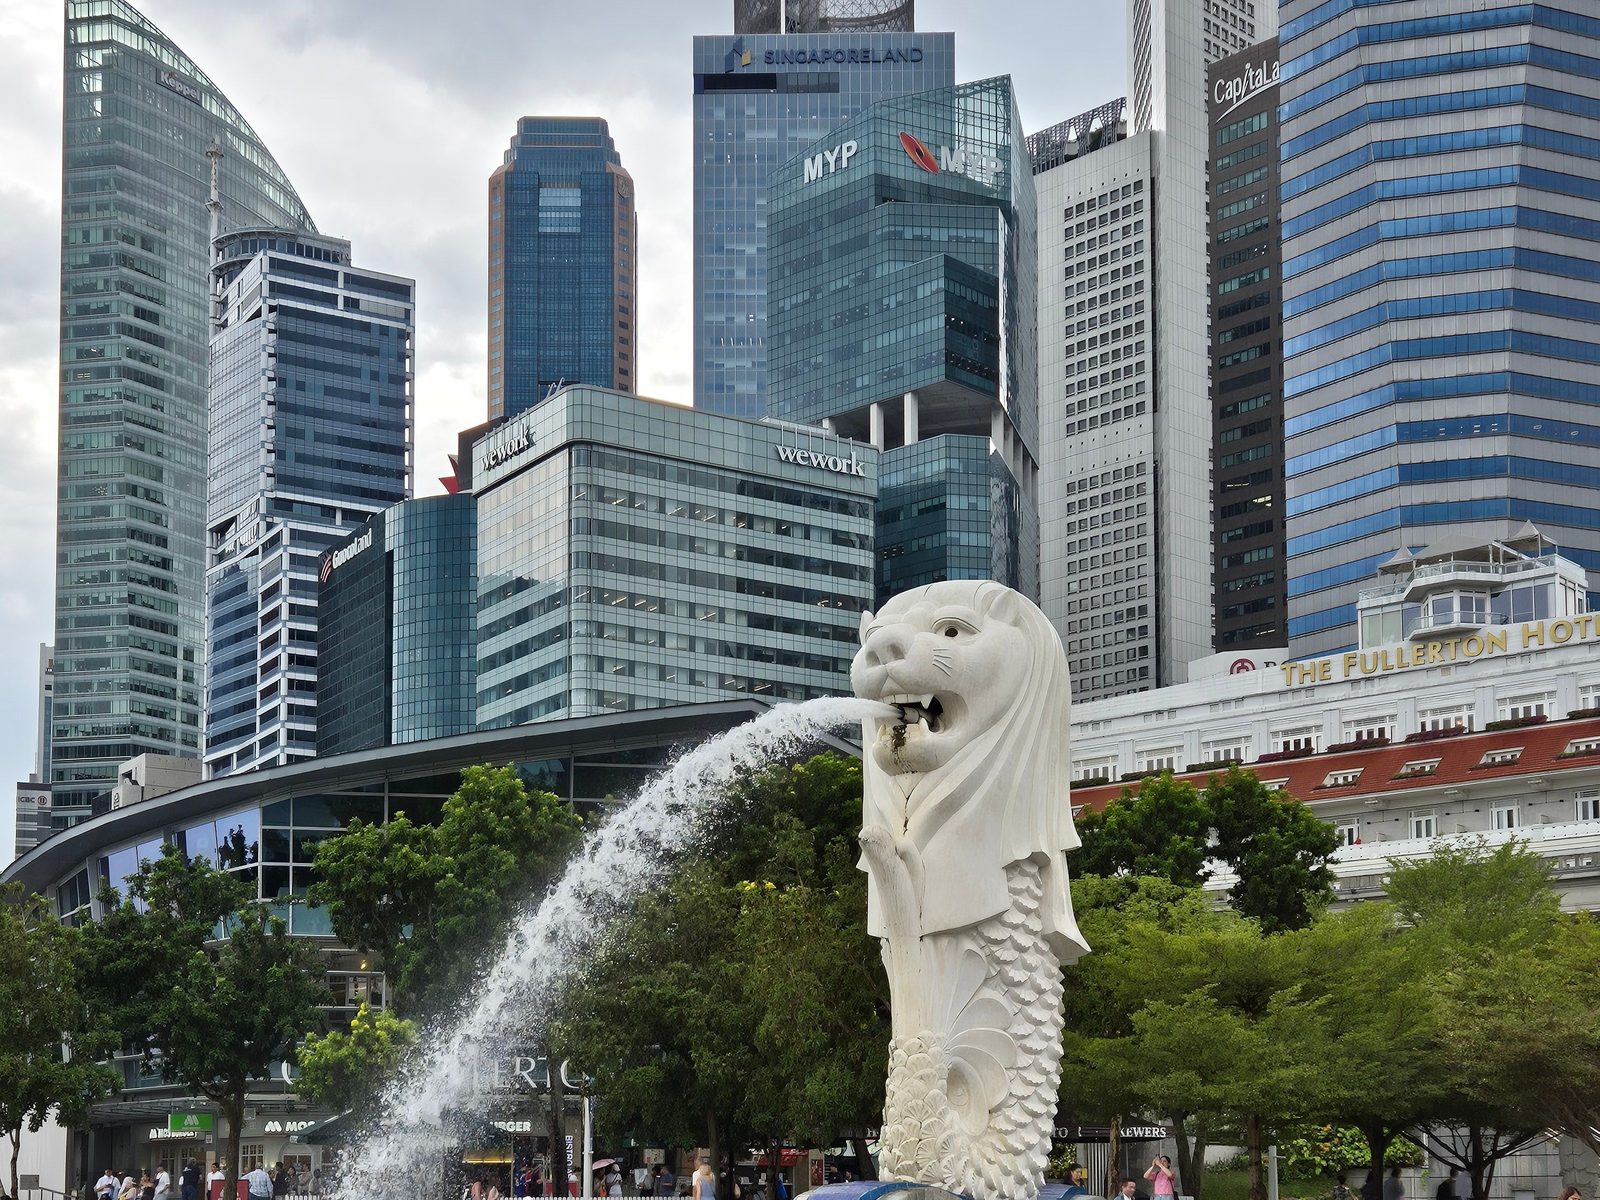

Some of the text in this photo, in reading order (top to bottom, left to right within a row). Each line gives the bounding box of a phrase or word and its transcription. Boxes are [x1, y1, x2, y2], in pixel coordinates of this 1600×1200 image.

[764, 47, 924, 65] SINGAPORELAND
[160, 71, 200, 101] Keppel
[803, 140, 858, 184] MYP
[940, 145, 1004, 181] MYP
[480, 422, 530, 472] wework
[775, 444, 866, 477] wework
[1280, 659, 1332, 687] THE
[1343, 629, 1508, 678] FULLERTON
